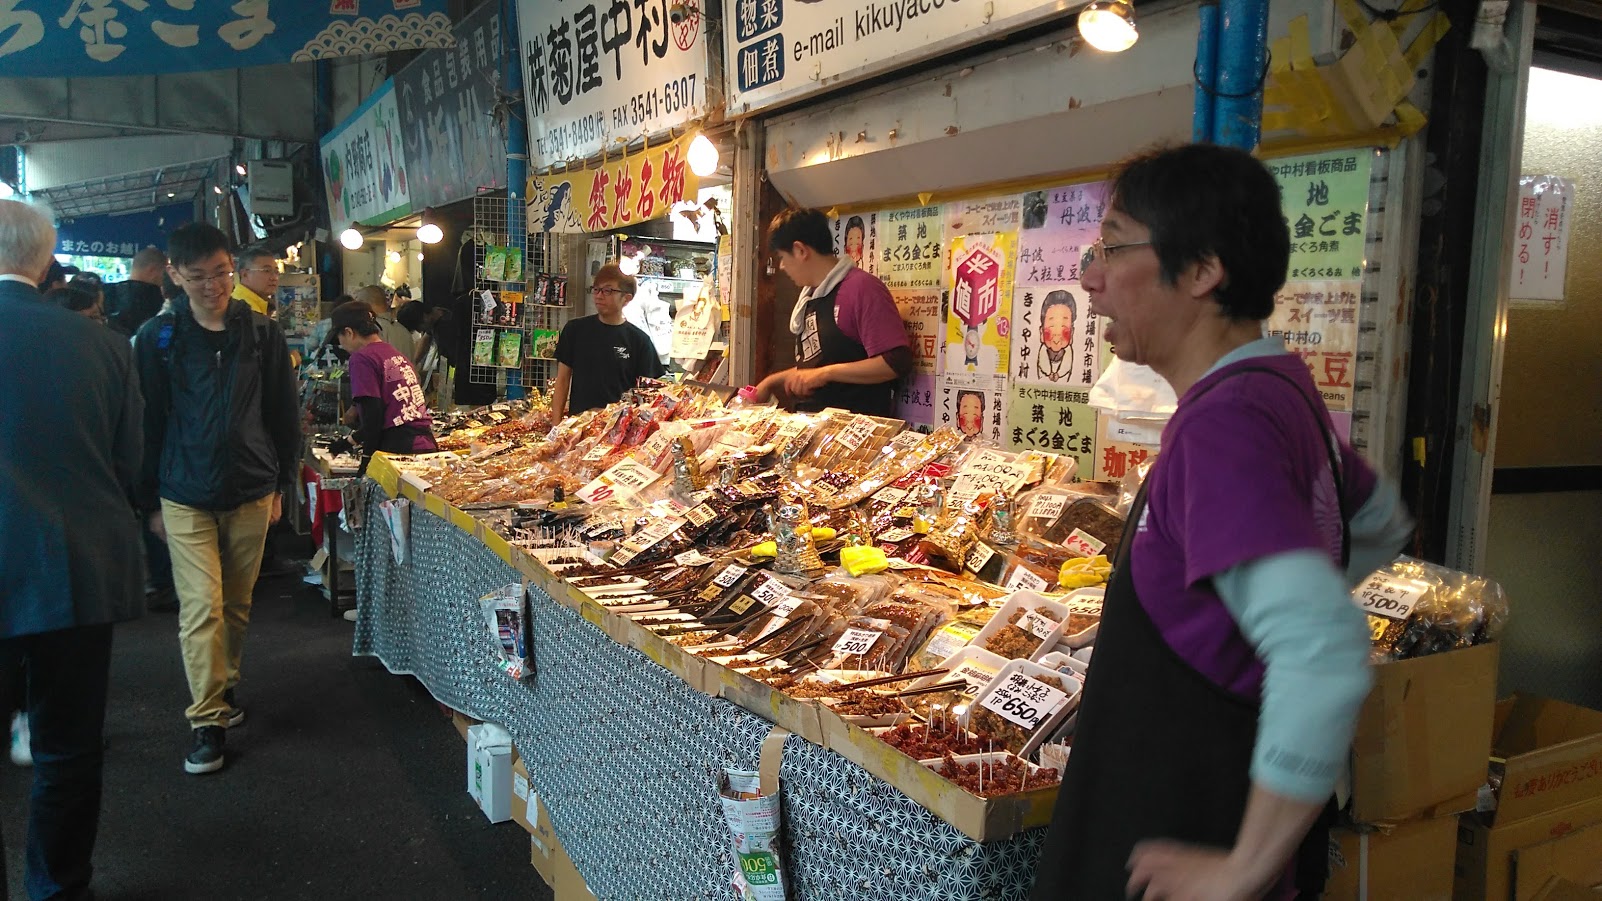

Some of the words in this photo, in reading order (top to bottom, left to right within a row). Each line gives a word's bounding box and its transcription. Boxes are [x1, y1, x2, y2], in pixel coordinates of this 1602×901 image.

[793, 17, 844, 62] e-mail
[855, 0, 967, 41] kikuyaco
[741, 39, 780, 88] 佃煮
[536, 136, 549, 155] TEL
[612, 103, 629, 130] FAX
[630, 73, 697, 124] 3541-6307
[587, 144, 686, 231] 築地名物
[1306, 180, 1330, 207] 地
[897, 222, 928, 241] 築地
[1293, 209, 1362, 239] 金ごま
[61, 239, 156, 255] またのお越し
[883, 241, 941, 262] まぐろ金ごま
[1020, 246, 1044, 263] 丹波
[1289, 241, 1340, 253] まぐろ角煮
[1027, 264, 1079, 282] 大粒黒豆
[1288, 308, 1355, 323] スイーツ豆
[1018, 292, 1034, 379] きくや中村
[1082, 291, 1097, 384] 地場外市場
[1268, 329, 1322, 344] 中村の
[1018, 387, 1089, 405] きくや中村看板商品
[1032, 404, 1073, 427] 築地
[1012, 426, 1093, 454] まぐろ金ごま
[1362, 593, 1410, 616] 500円
[841, 641, 868, 652] 500
[1001, 697, 1040, 727] 650円
